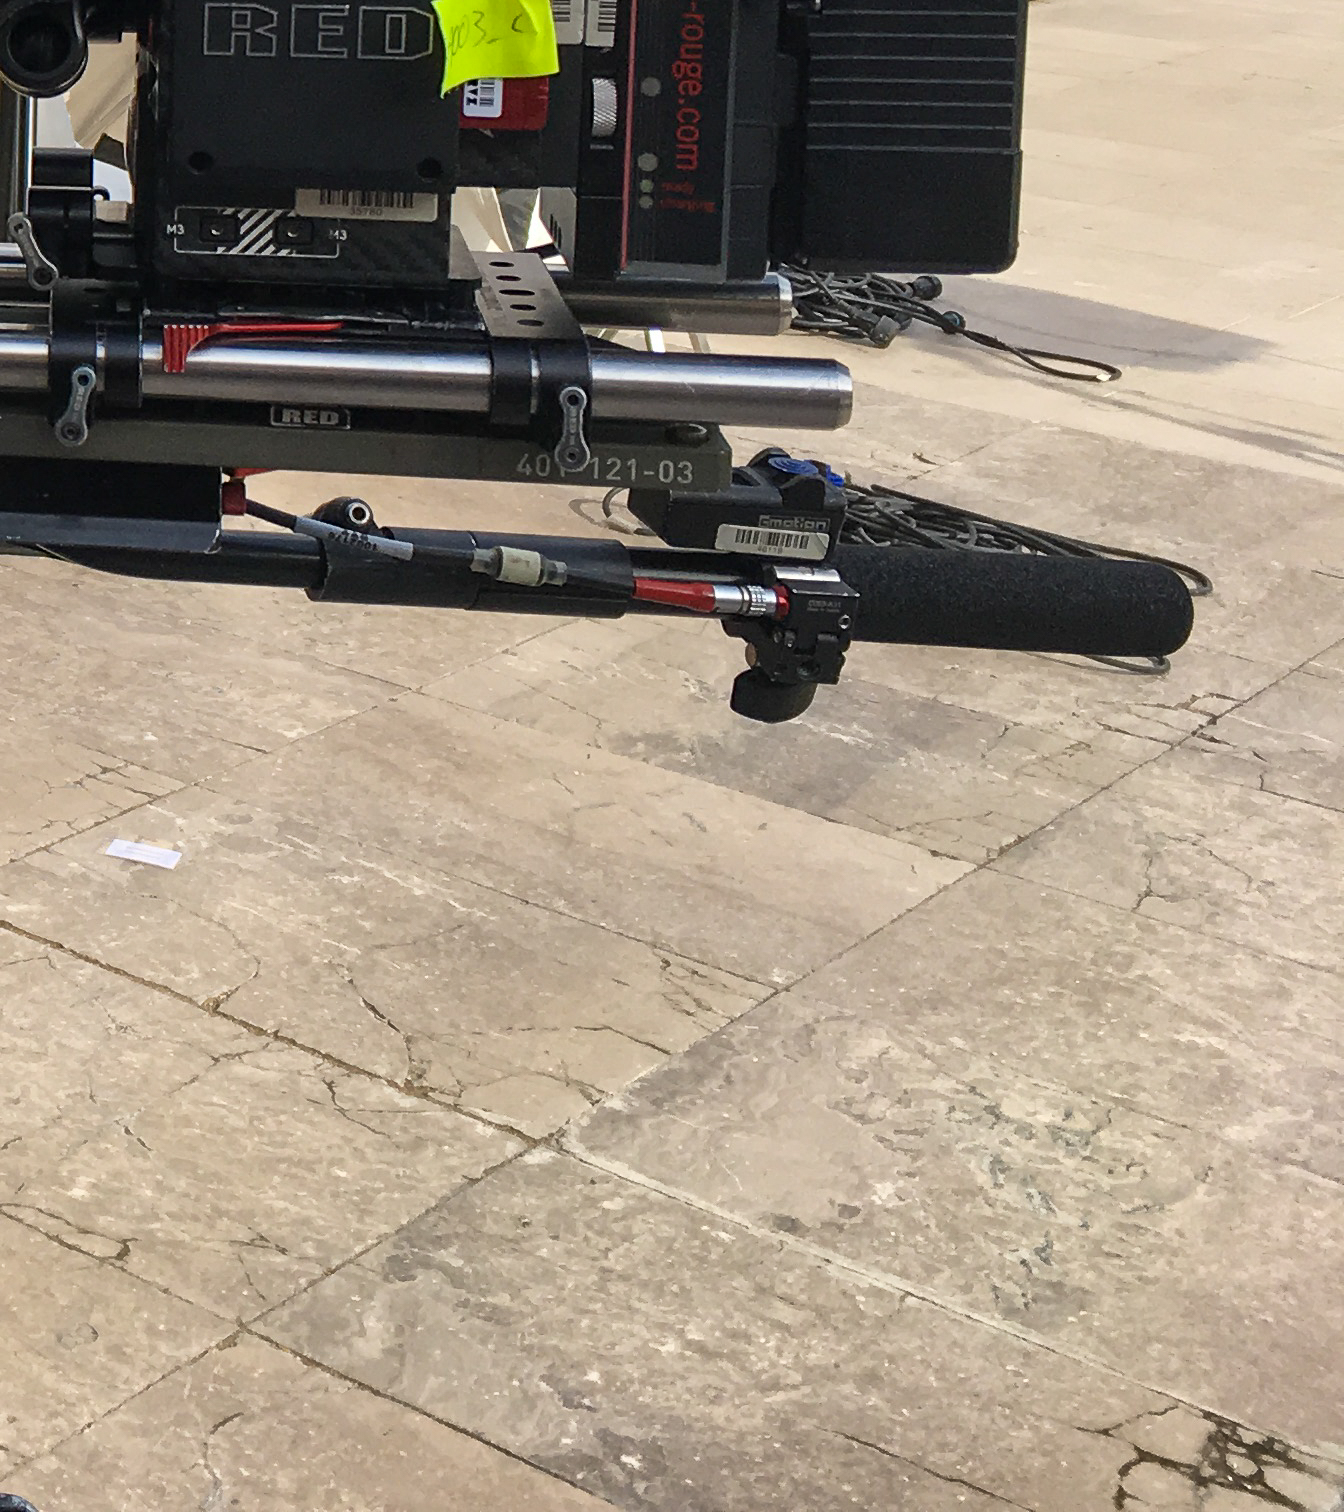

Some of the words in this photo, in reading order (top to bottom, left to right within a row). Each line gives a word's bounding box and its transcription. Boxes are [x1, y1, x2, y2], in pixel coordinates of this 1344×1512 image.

[203, 2, 434, 59] RED
[166, 224, 185, 235] M3
[281, 408, 340, 425] RED
